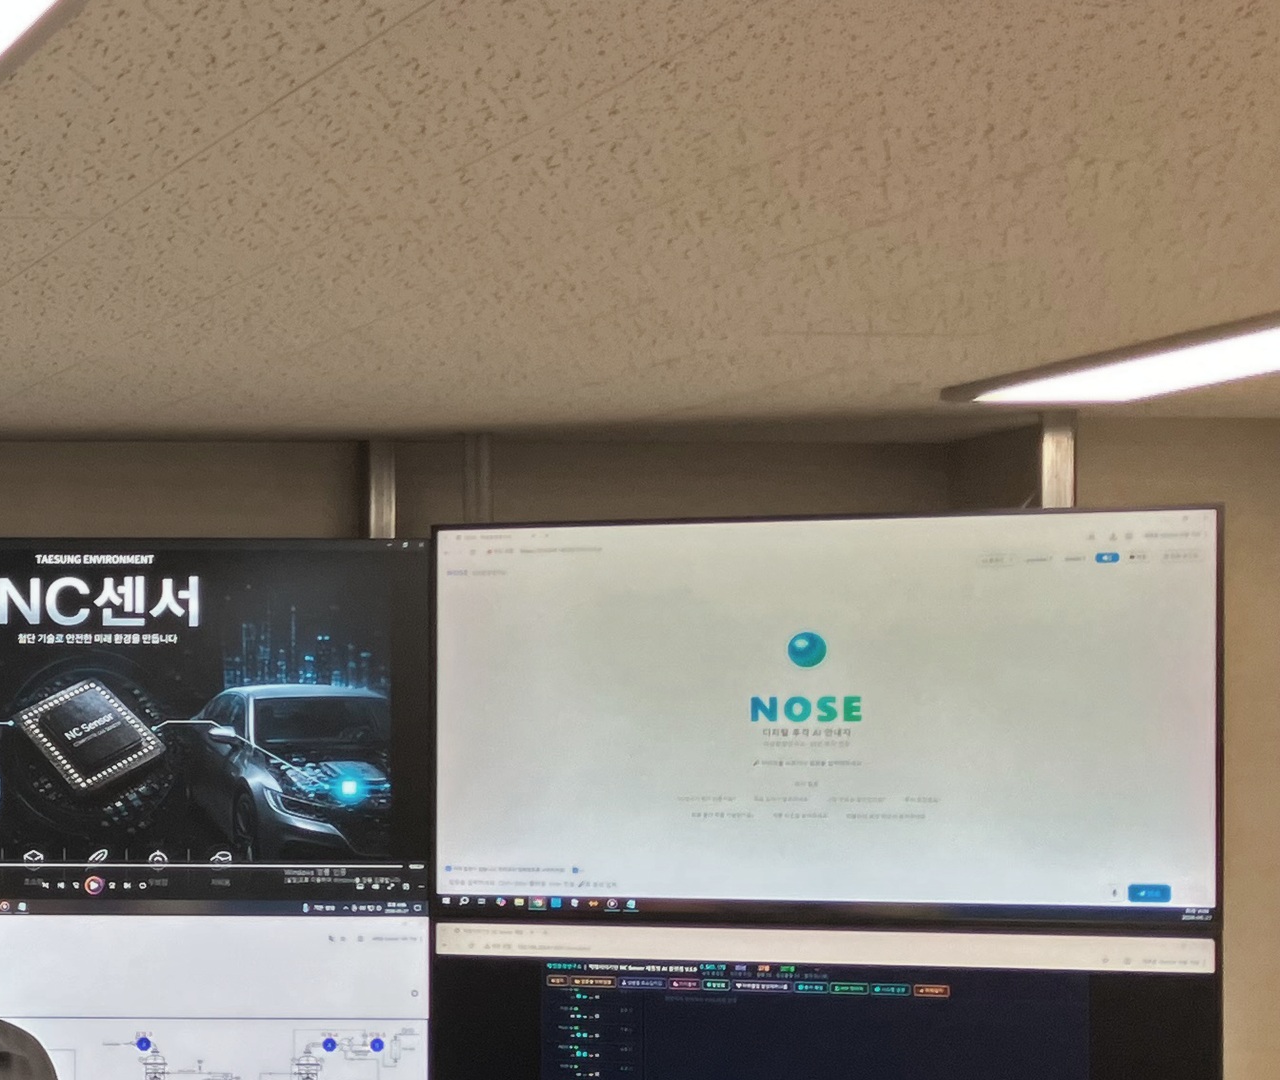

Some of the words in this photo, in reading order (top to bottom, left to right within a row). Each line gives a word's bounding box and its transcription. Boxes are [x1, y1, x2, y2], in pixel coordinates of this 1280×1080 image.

[35, 555, 82, 565] TAESUNG
[83, 555, 155, 565] ENVIRONMENT
[37, 633, 64, 645] 기술로
[65, 633, 93, 645] 안전한
[94, 633, 112, 645] 미래
[113, 633, 140, 645] 환경을
[750, 695, 862, 723] NOSE
[64, 727, 83, 741] NC
[80, 712, 114, 733] Sensor
